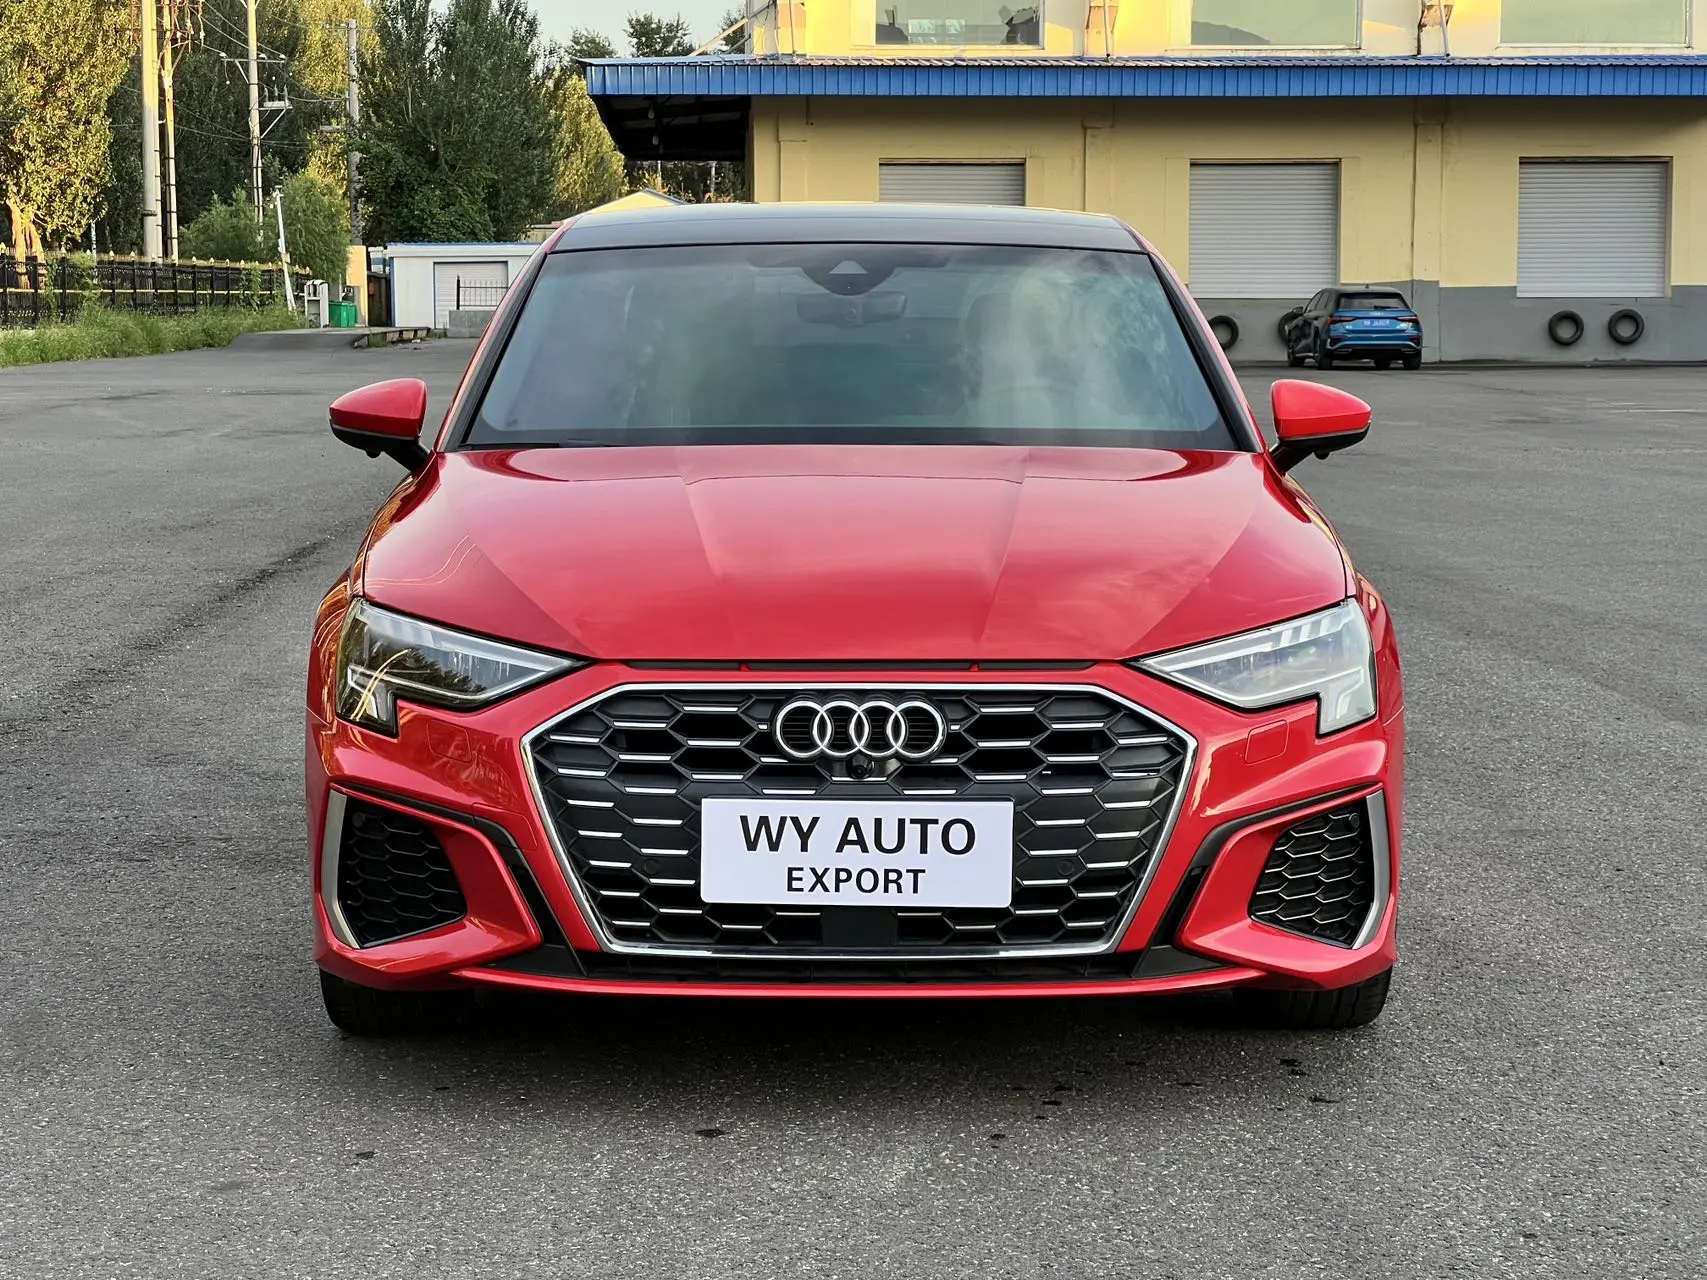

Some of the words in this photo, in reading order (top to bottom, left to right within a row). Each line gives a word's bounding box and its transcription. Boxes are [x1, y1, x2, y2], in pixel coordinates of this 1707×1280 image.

[740, 816, 820, 852] WY
[835, 817, 975, 855] AUTO
[787, 867, 925, 893] EXPORT
